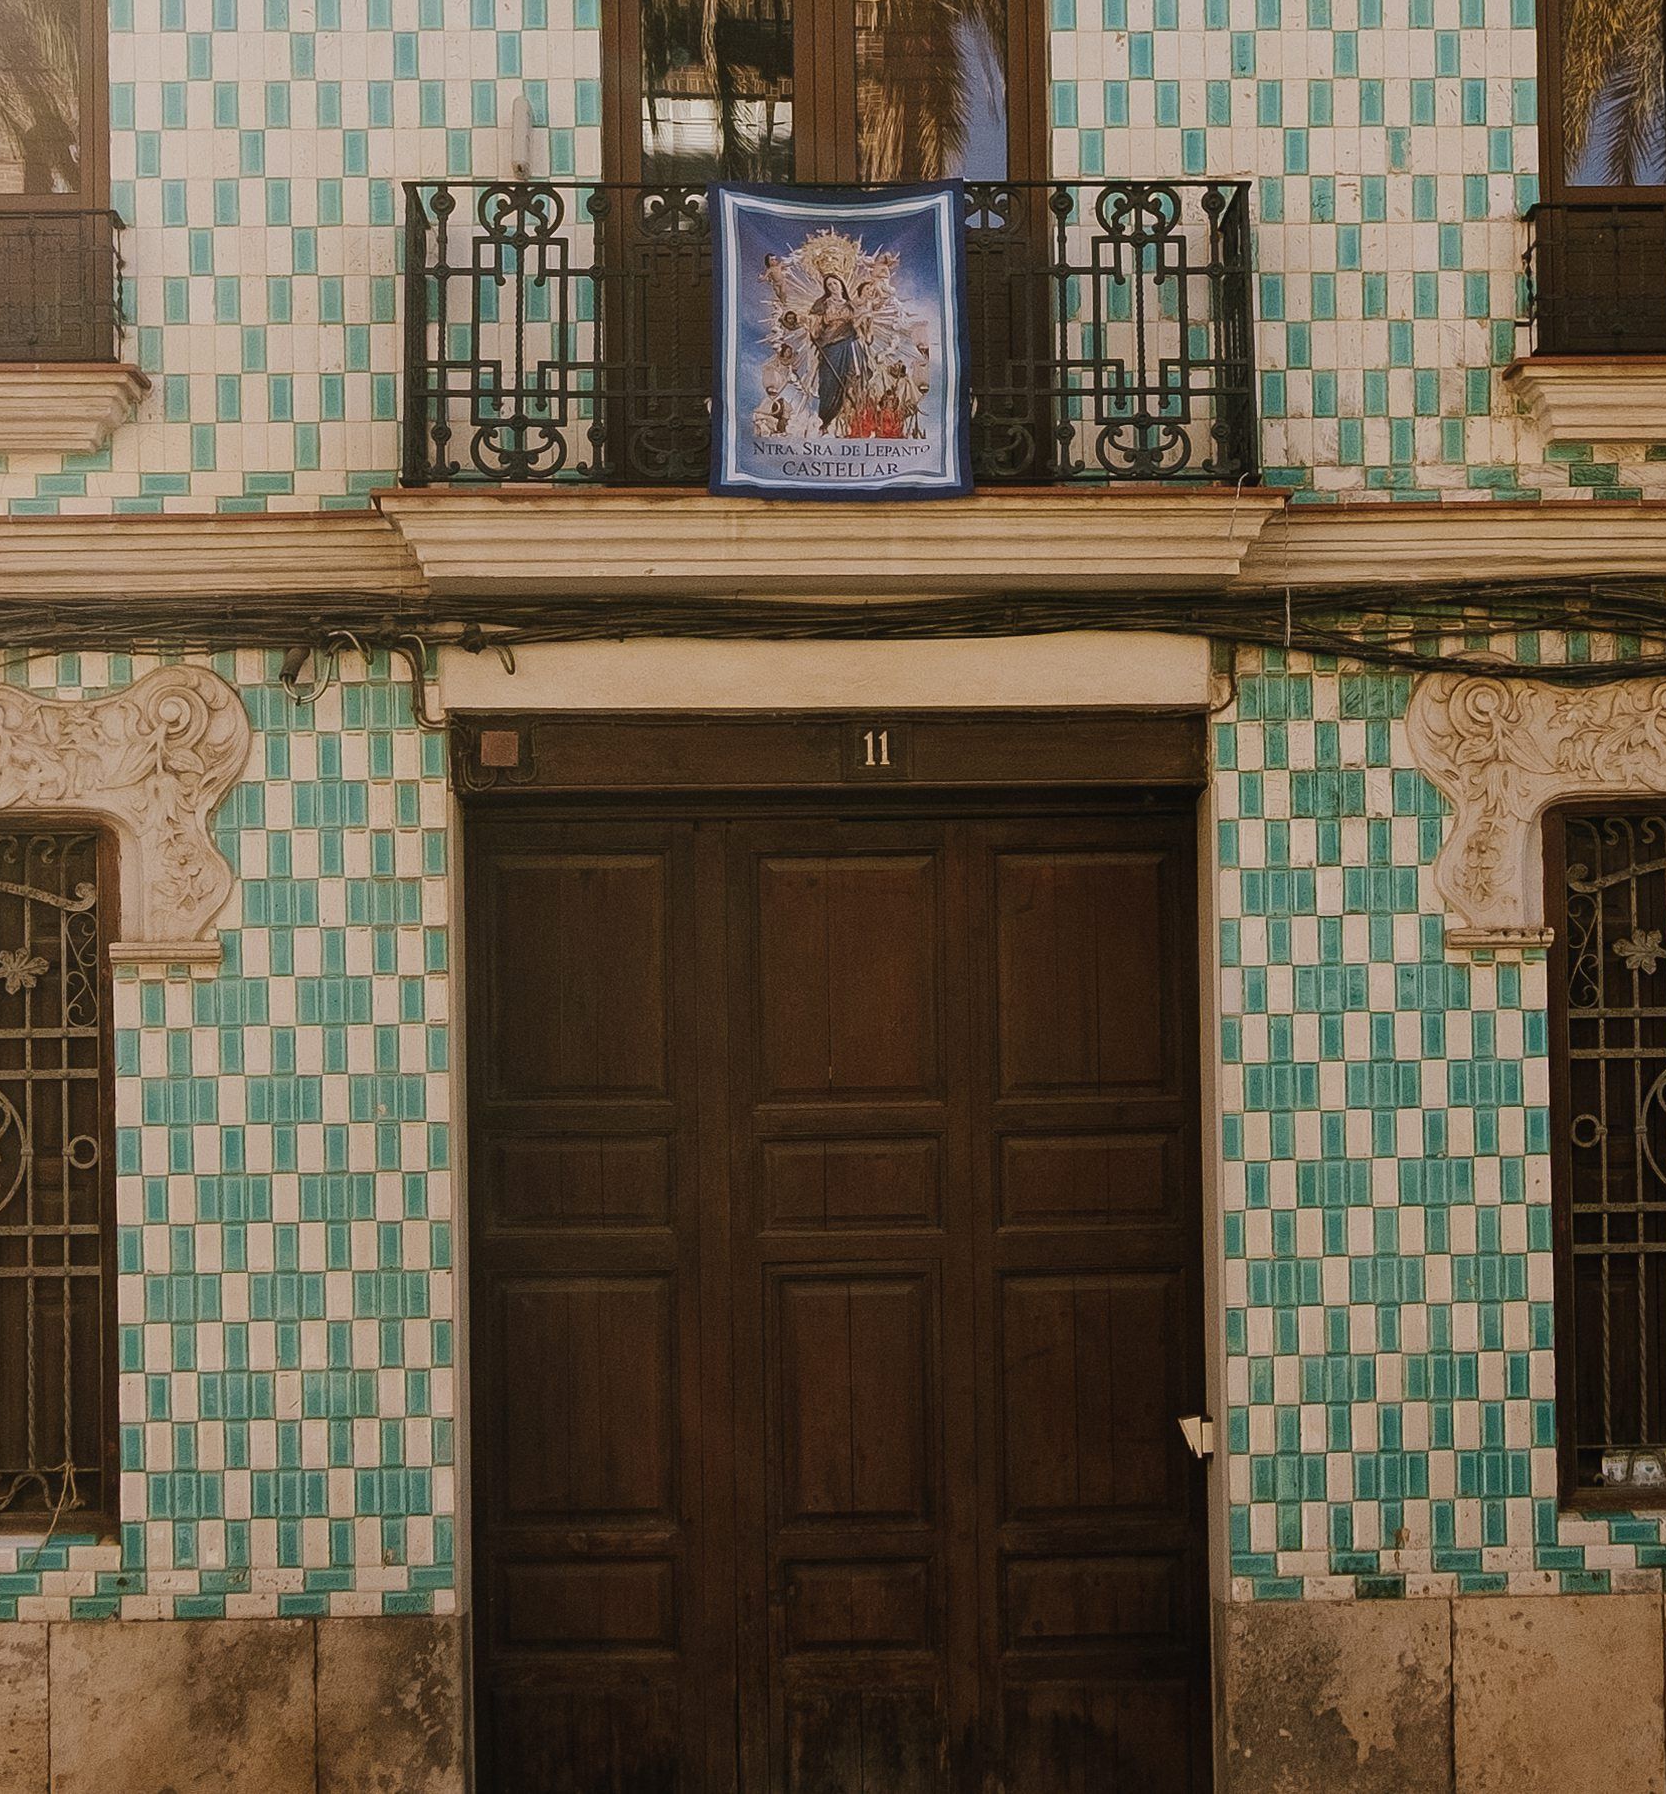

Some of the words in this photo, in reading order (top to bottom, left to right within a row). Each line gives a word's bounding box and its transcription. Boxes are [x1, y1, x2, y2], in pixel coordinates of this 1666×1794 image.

[841, 444, 861, 456] DE
[865, 443, 931, 457] LEPANTO
[783, 460, 900, 478] CASTELLAR
[863, 730, 890, 766] 11
